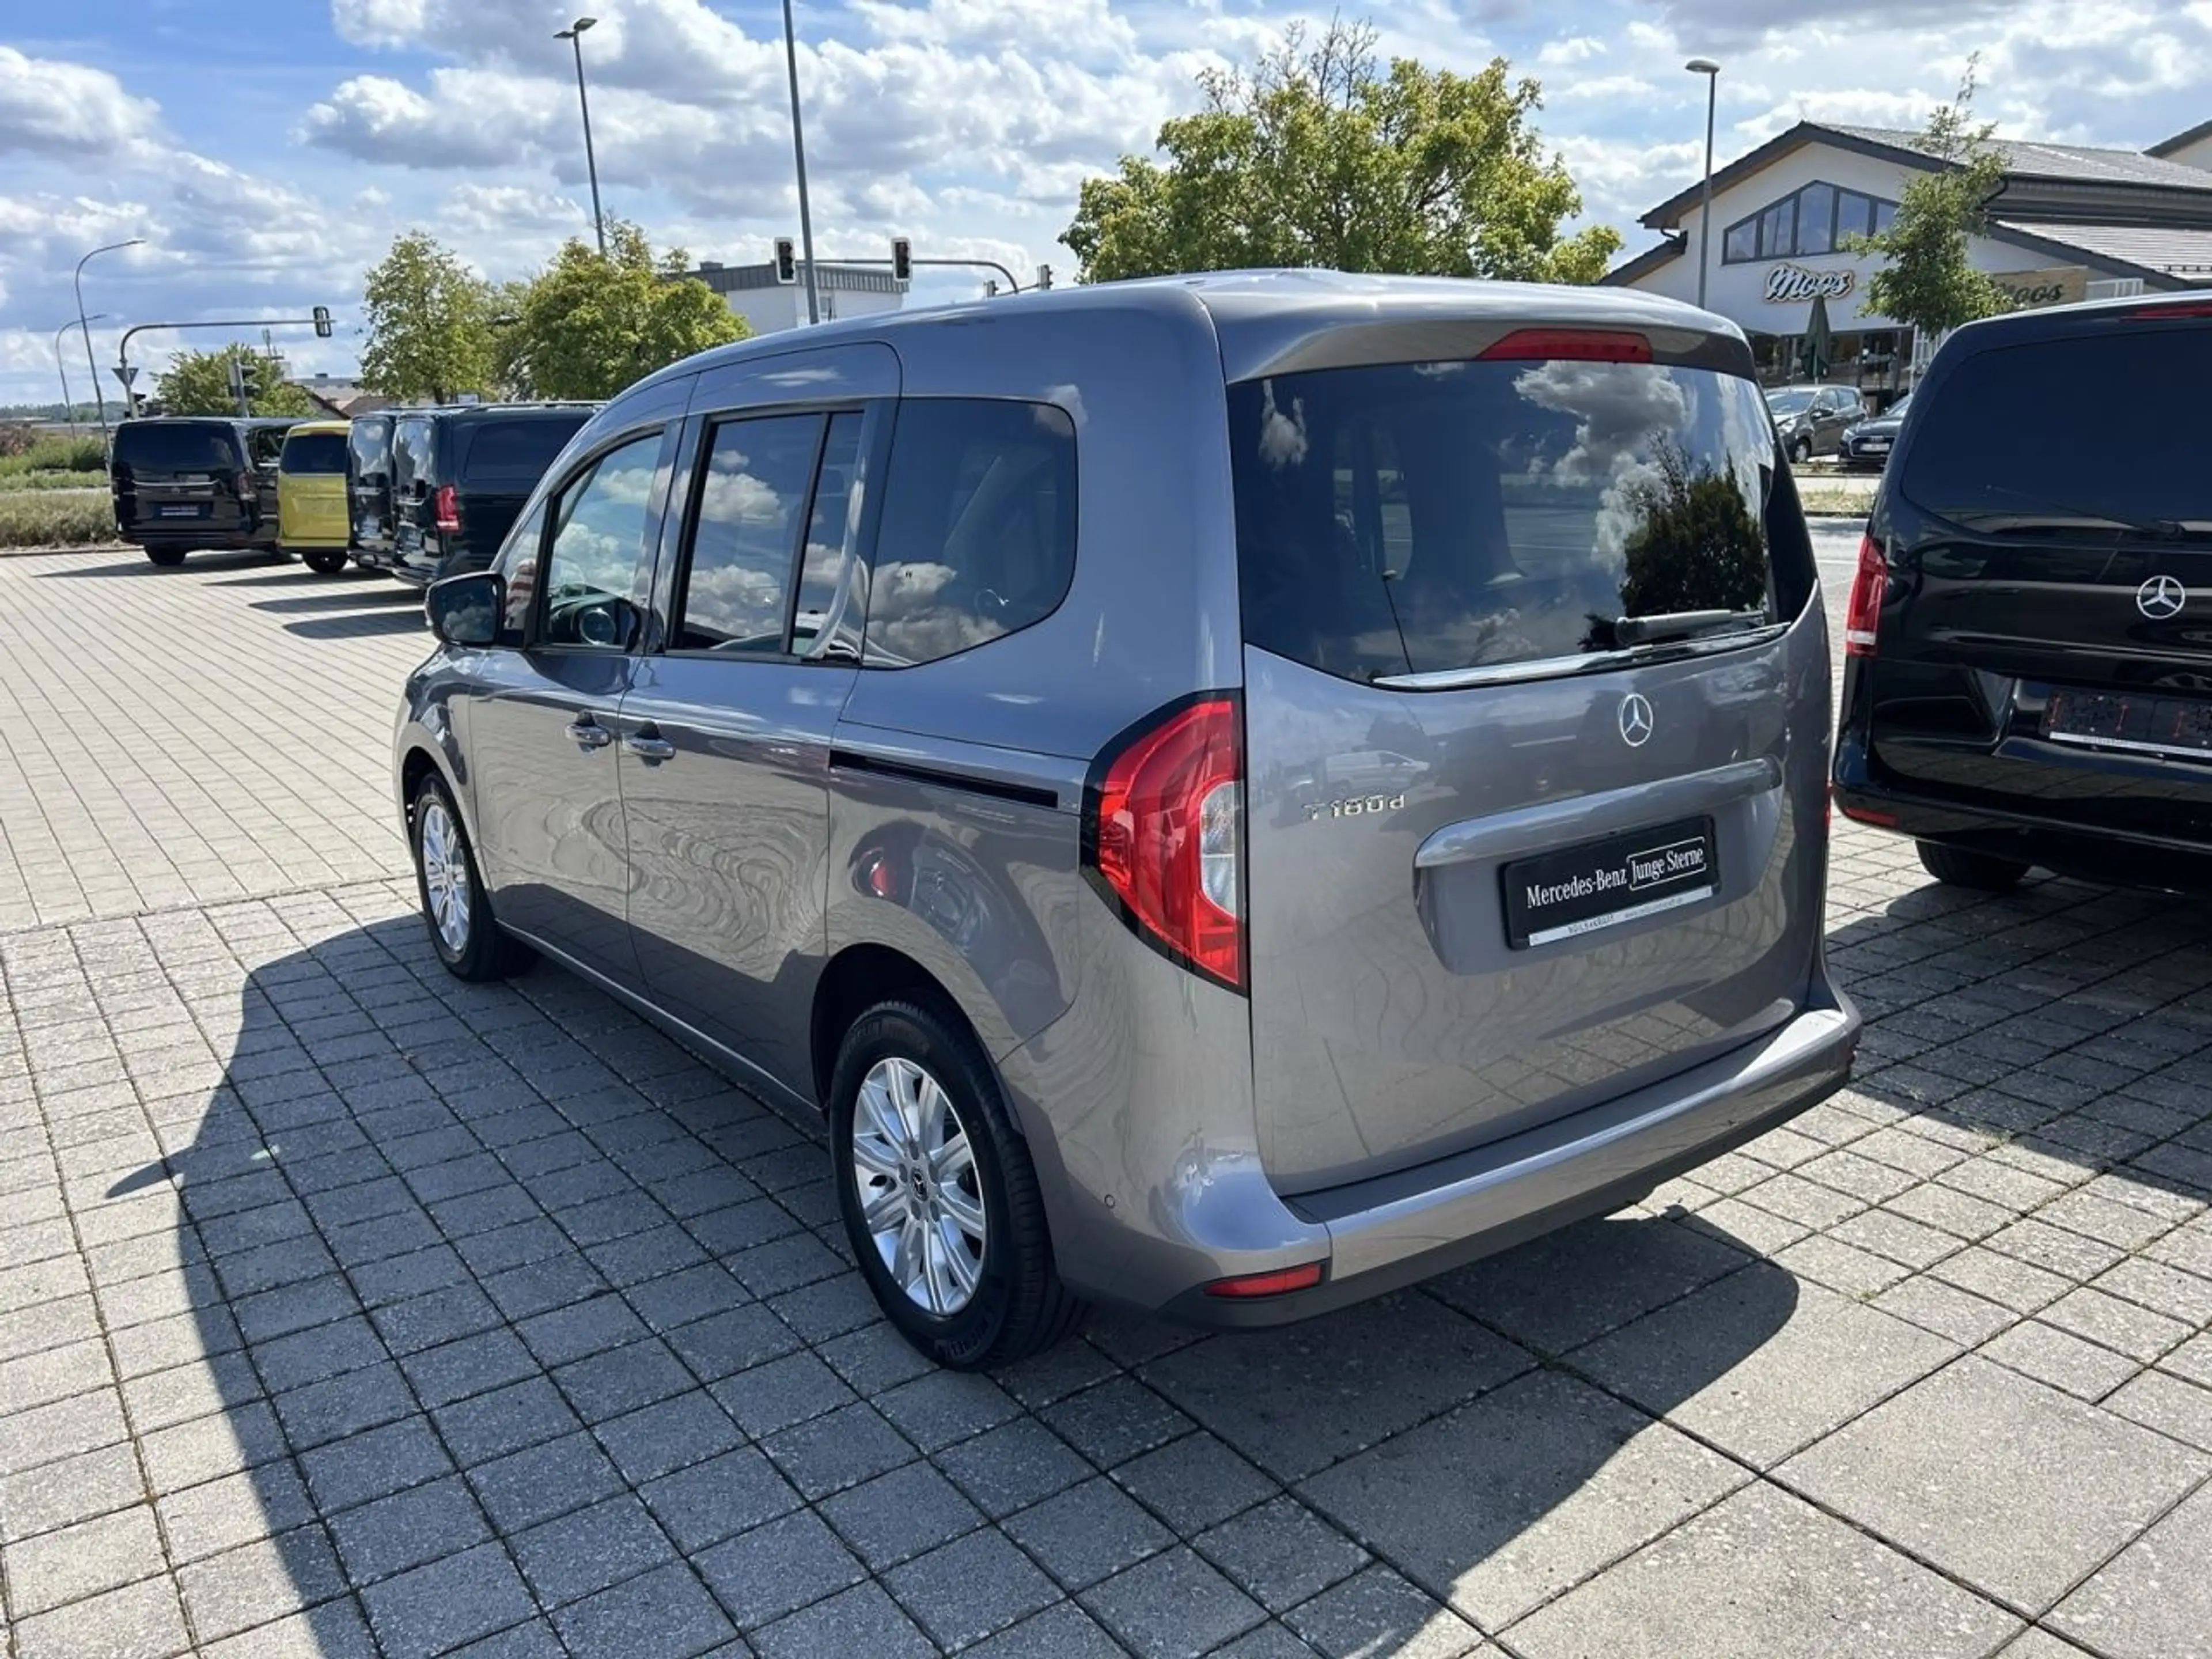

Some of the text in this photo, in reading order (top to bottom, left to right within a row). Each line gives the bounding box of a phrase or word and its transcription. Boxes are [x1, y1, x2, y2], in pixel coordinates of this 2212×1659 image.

[1527, 869, 1627, 908] Mercedes-Benz
[1632, 859, 1665, 884] Junge
[1666, 847, 1704, 872] Sterne
